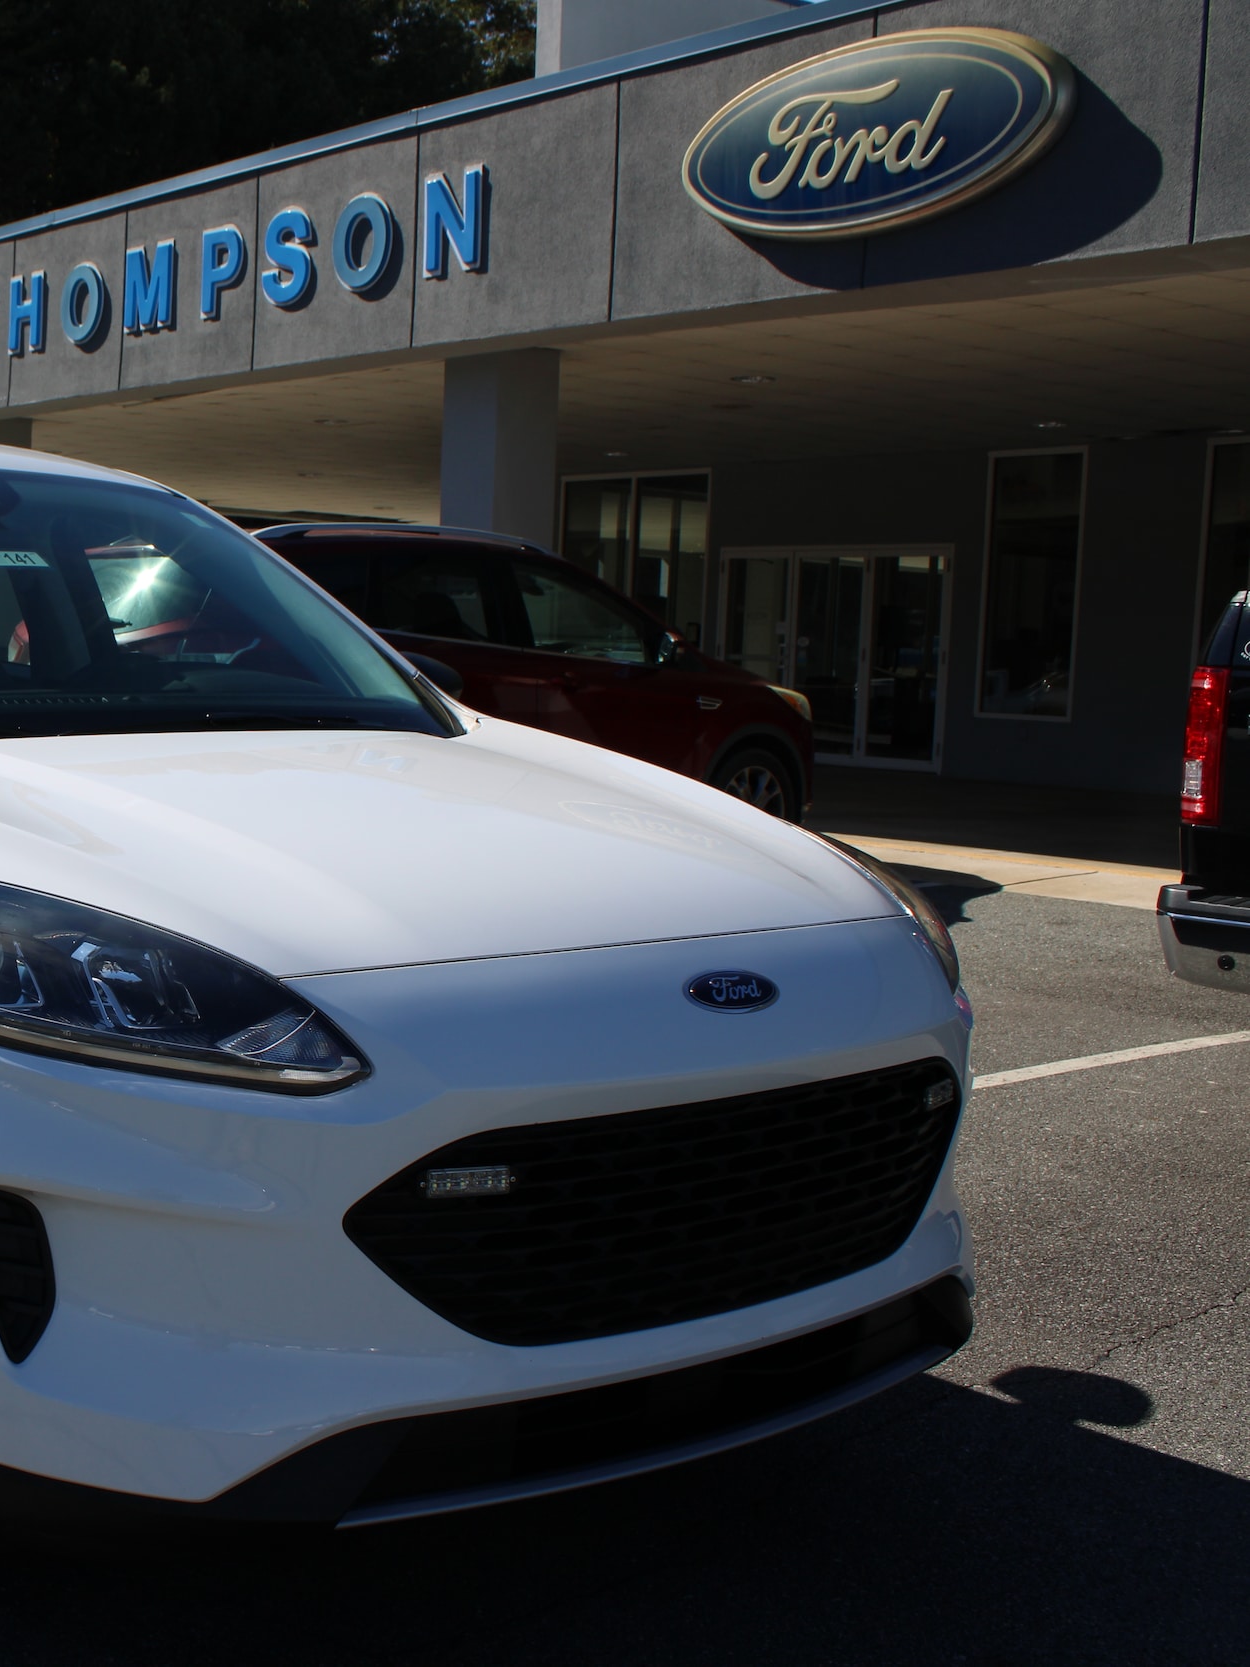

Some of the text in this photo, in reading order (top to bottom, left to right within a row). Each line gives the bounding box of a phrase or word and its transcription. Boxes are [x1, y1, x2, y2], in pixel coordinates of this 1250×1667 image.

[749, 78, 954, 200] Ford
[3, 553, 37, 565] 141
[709, 975, 763, 1002] Ford
